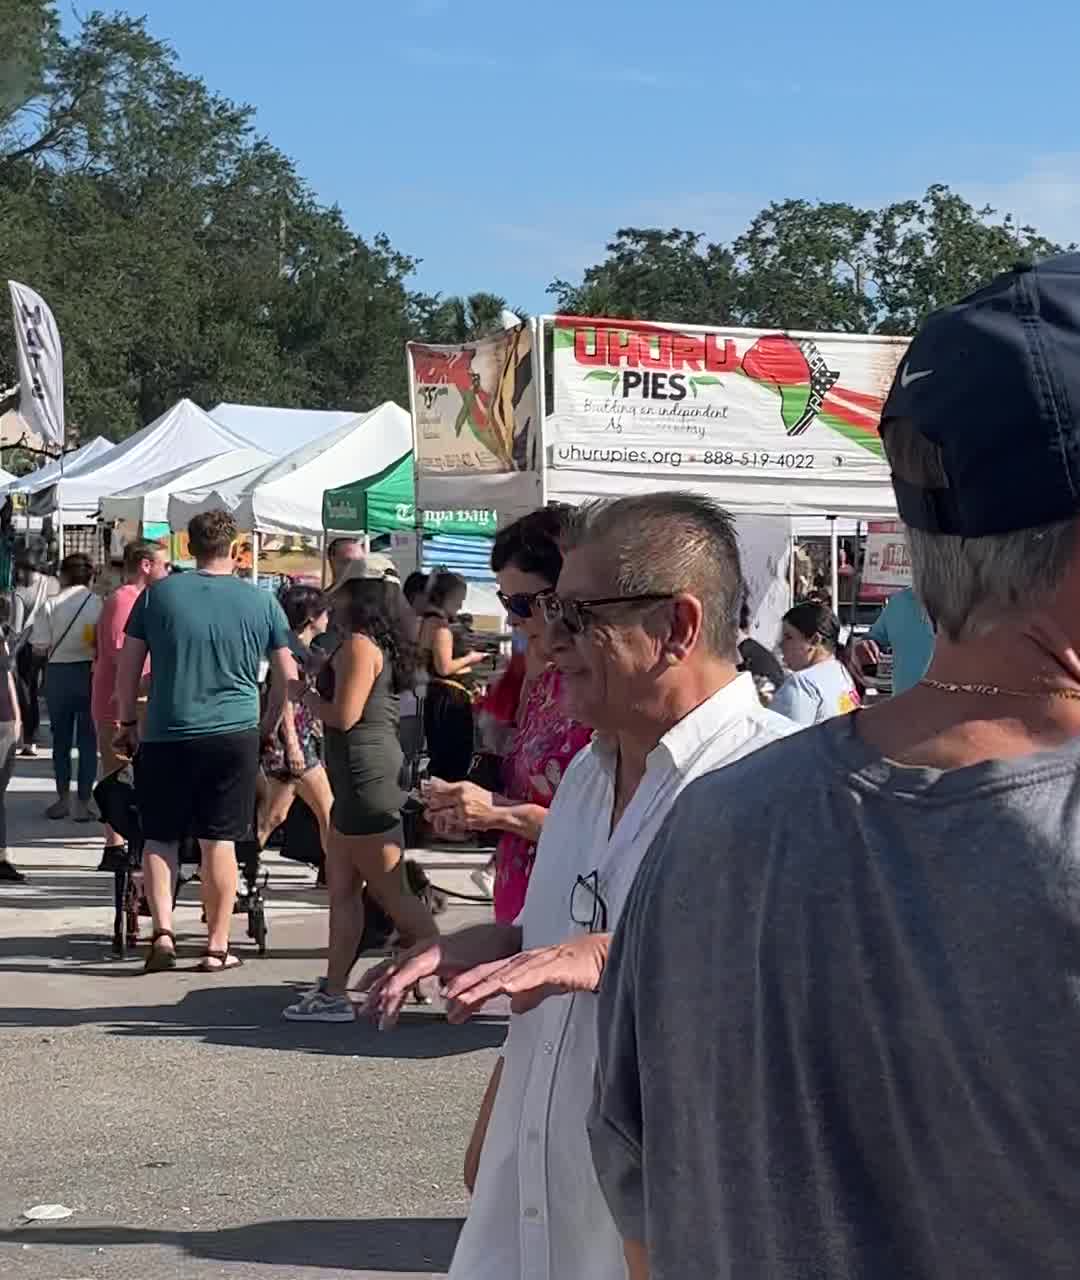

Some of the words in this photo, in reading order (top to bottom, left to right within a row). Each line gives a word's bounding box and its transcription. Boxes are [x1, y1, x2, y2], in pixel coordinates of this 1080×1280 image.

[574, 327, 741, 372] UHURU
[622, 371, 687, 401] PIES
[658, 402, 728, 422] independent
[559, 445, 682, 466] uhurupies.org
[703, 450, 815, 469] 888-519-4022
